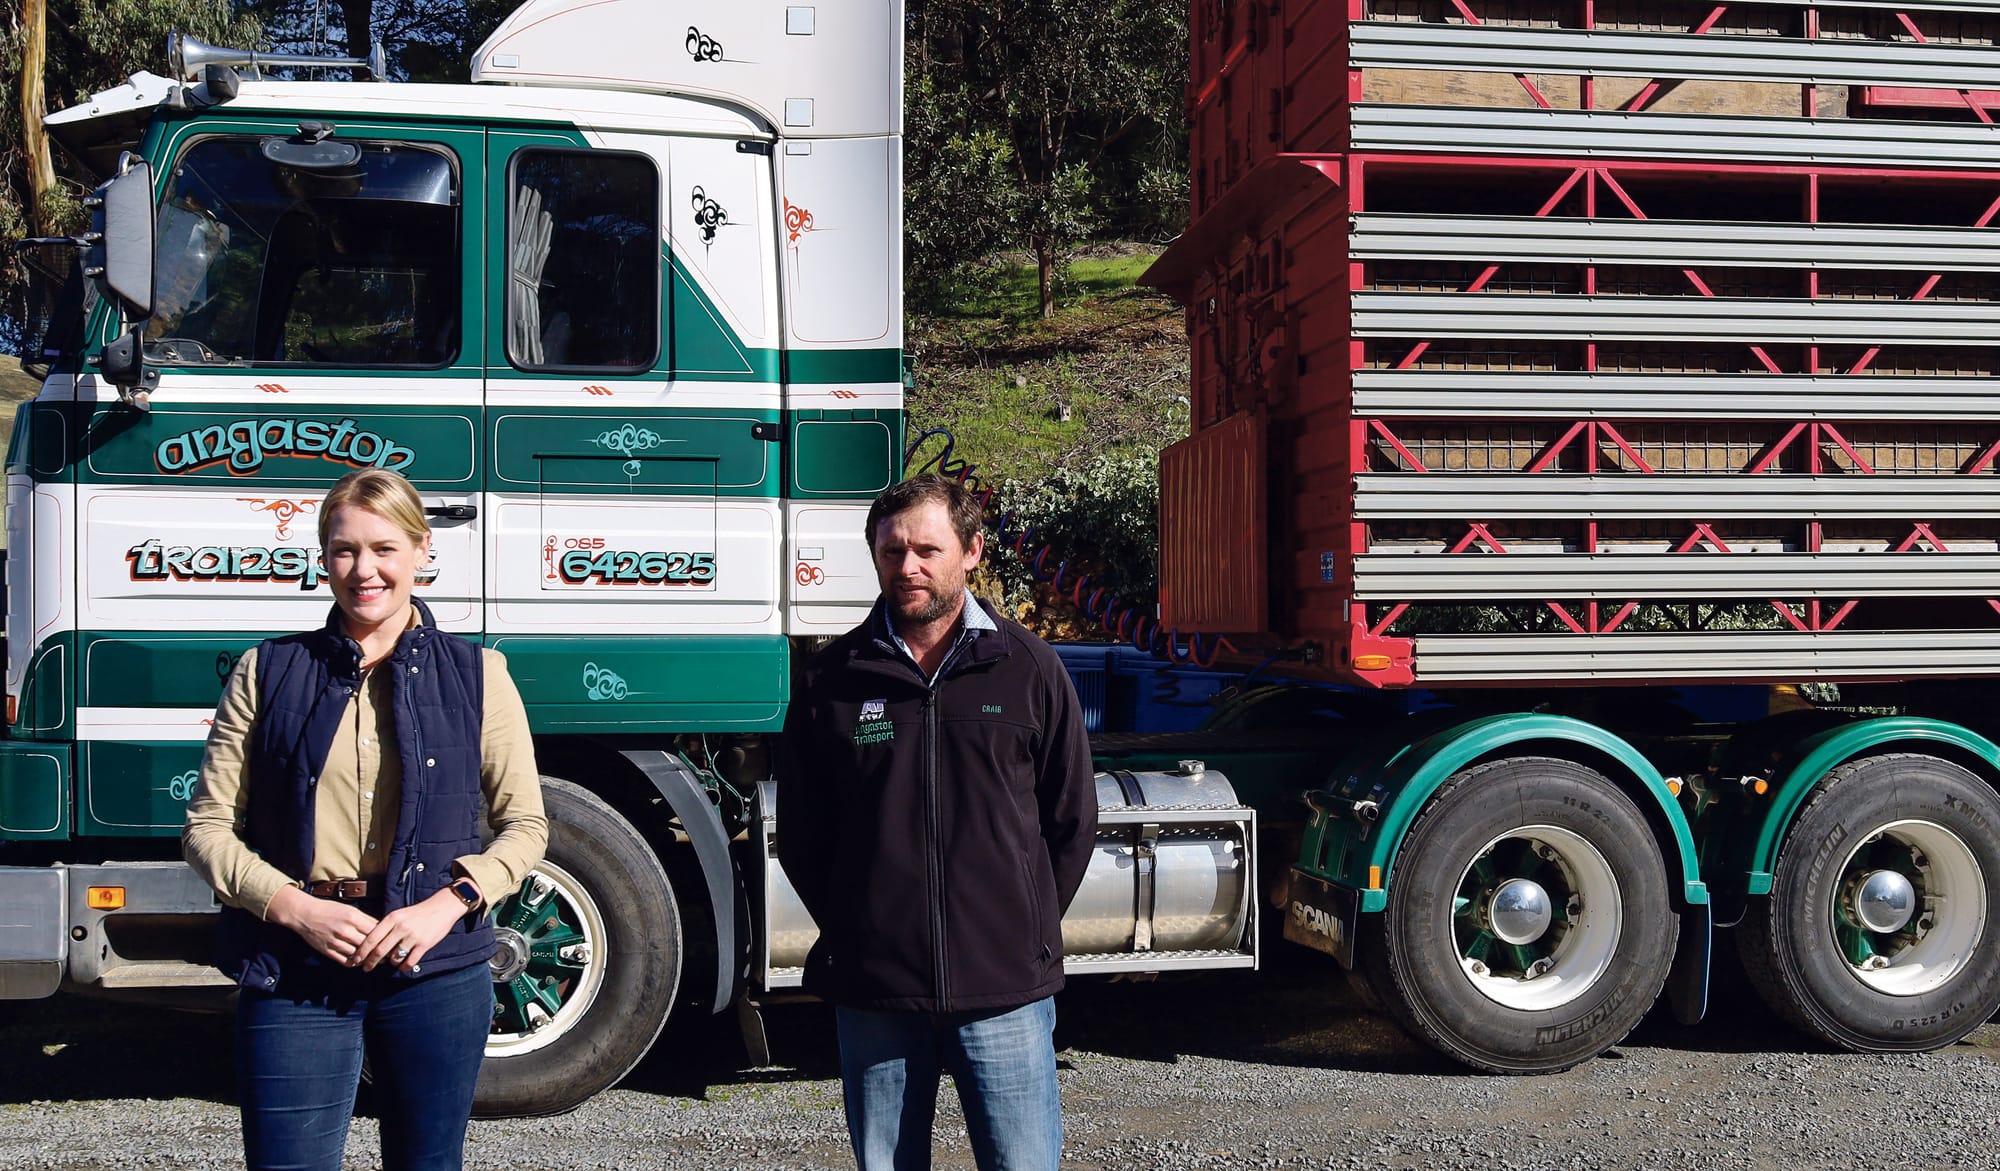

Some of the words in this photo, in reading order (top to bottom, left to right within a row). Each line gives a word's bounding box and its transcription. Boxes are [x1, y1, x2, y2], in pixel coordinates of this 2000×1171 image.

[153, 416, 415, 478] angaston
[125, 538, 438, 591] transp
[564, 537, 605, 549] 085
[559, 550, 717, 586] 642625
[853, 731, 895, 746] Transport
[1804, 823, 1848, 922] MICHELIN
[1292, 901, 1344, 947] SCANIA
[1537, 988, 1624, 1045] MICHELIN
